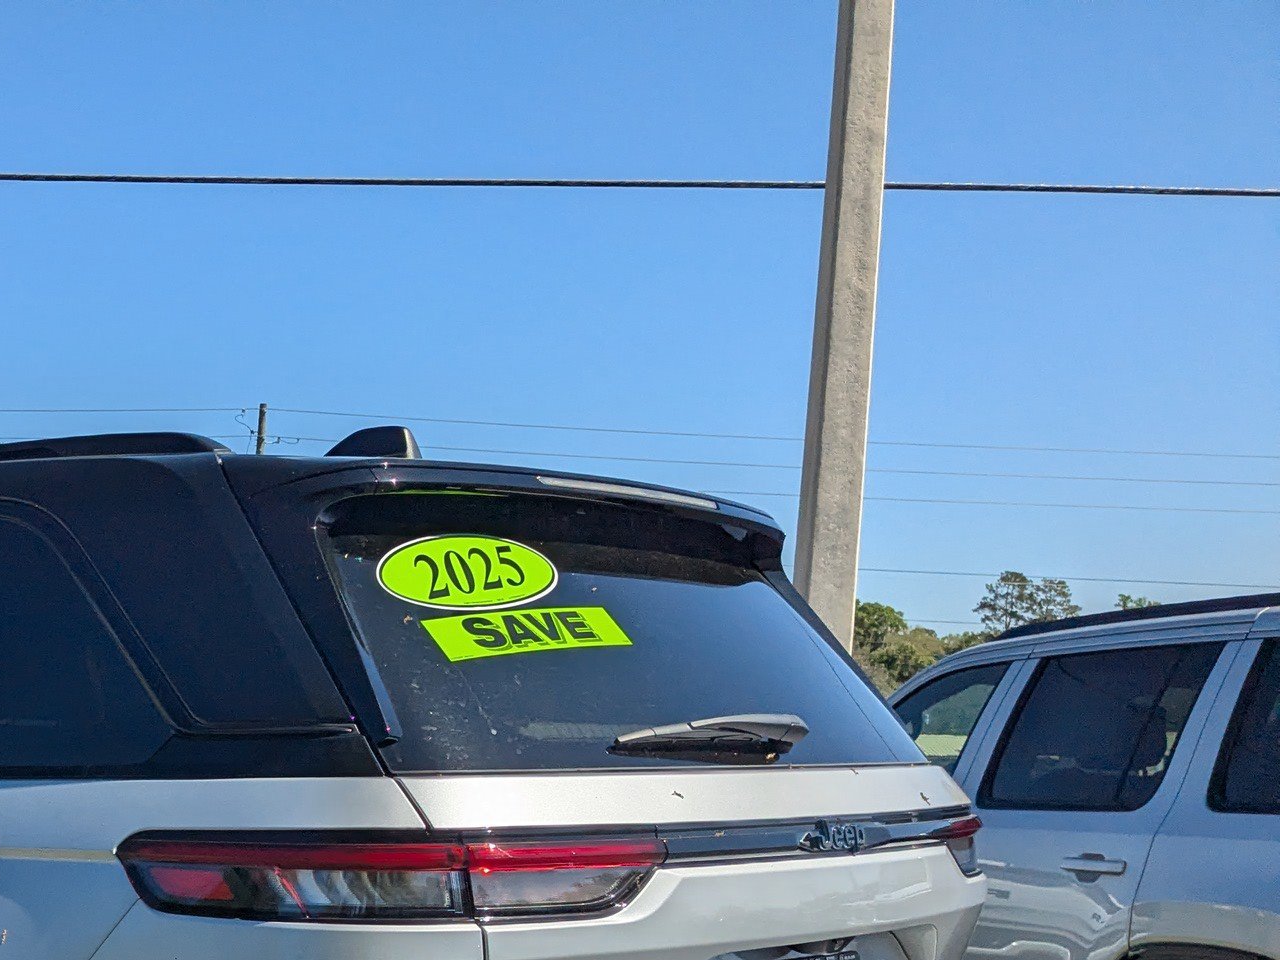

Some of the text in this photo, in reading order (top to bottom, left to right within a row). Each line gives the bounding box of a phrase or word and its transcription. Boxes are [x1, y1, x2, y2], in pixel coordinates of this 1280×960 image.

[413, 545, 526, 600] 2025
[461, 610, 603, 652] SAVE
[799, 818, 866, 856] Jeep
